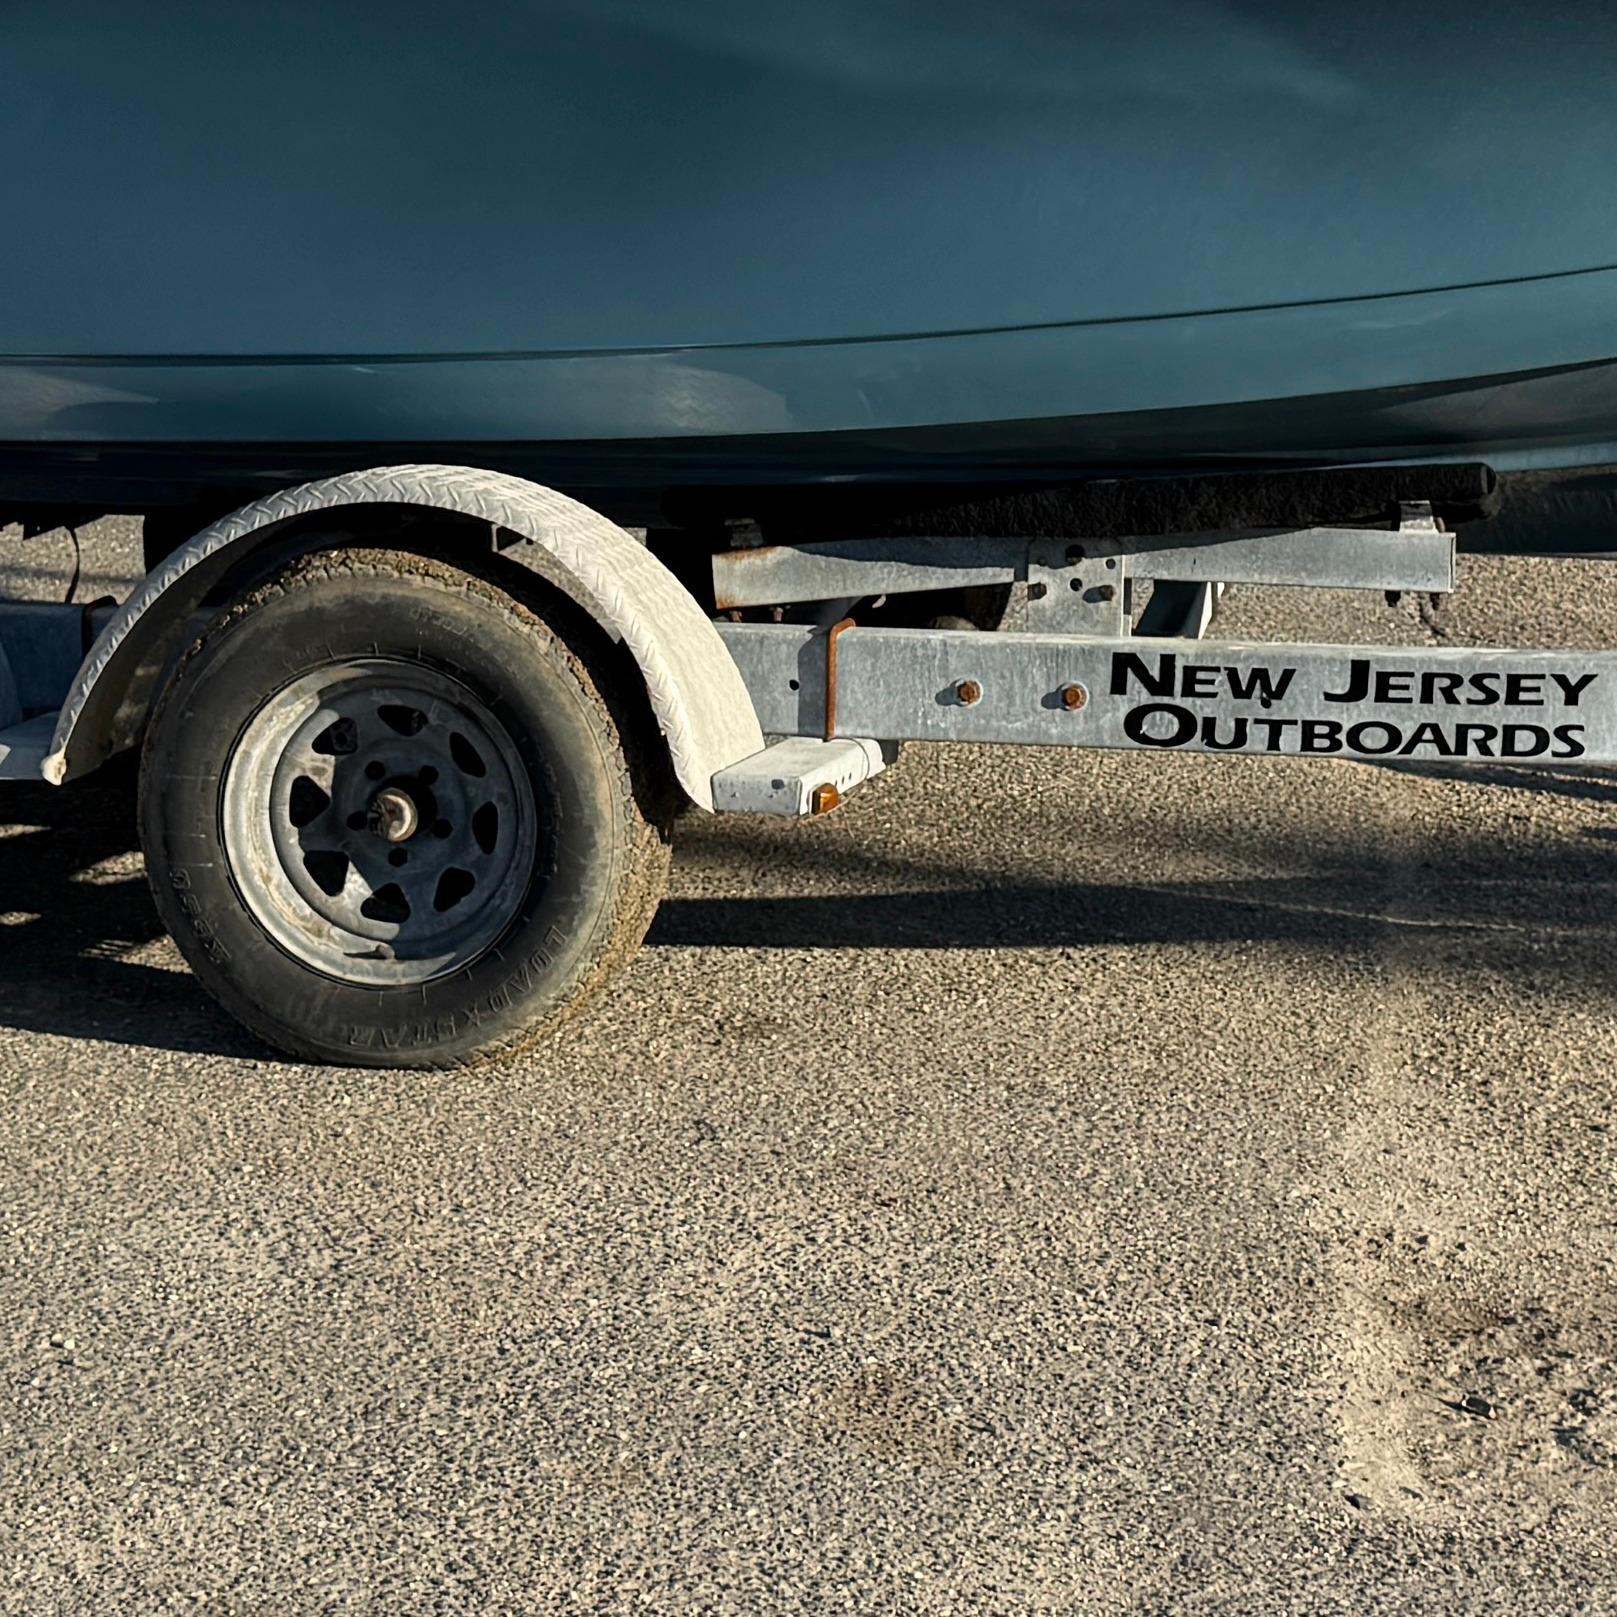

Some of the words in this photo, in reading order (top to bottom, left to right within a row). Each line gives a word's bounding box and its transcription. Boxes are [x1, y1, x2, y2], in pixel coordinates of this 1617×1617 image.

[1109, 652, 1296, 702] NEW
[1323, 659, 1598, 707] JERSEY
[1124, 703, 1586, 758] OUTBOARDS
